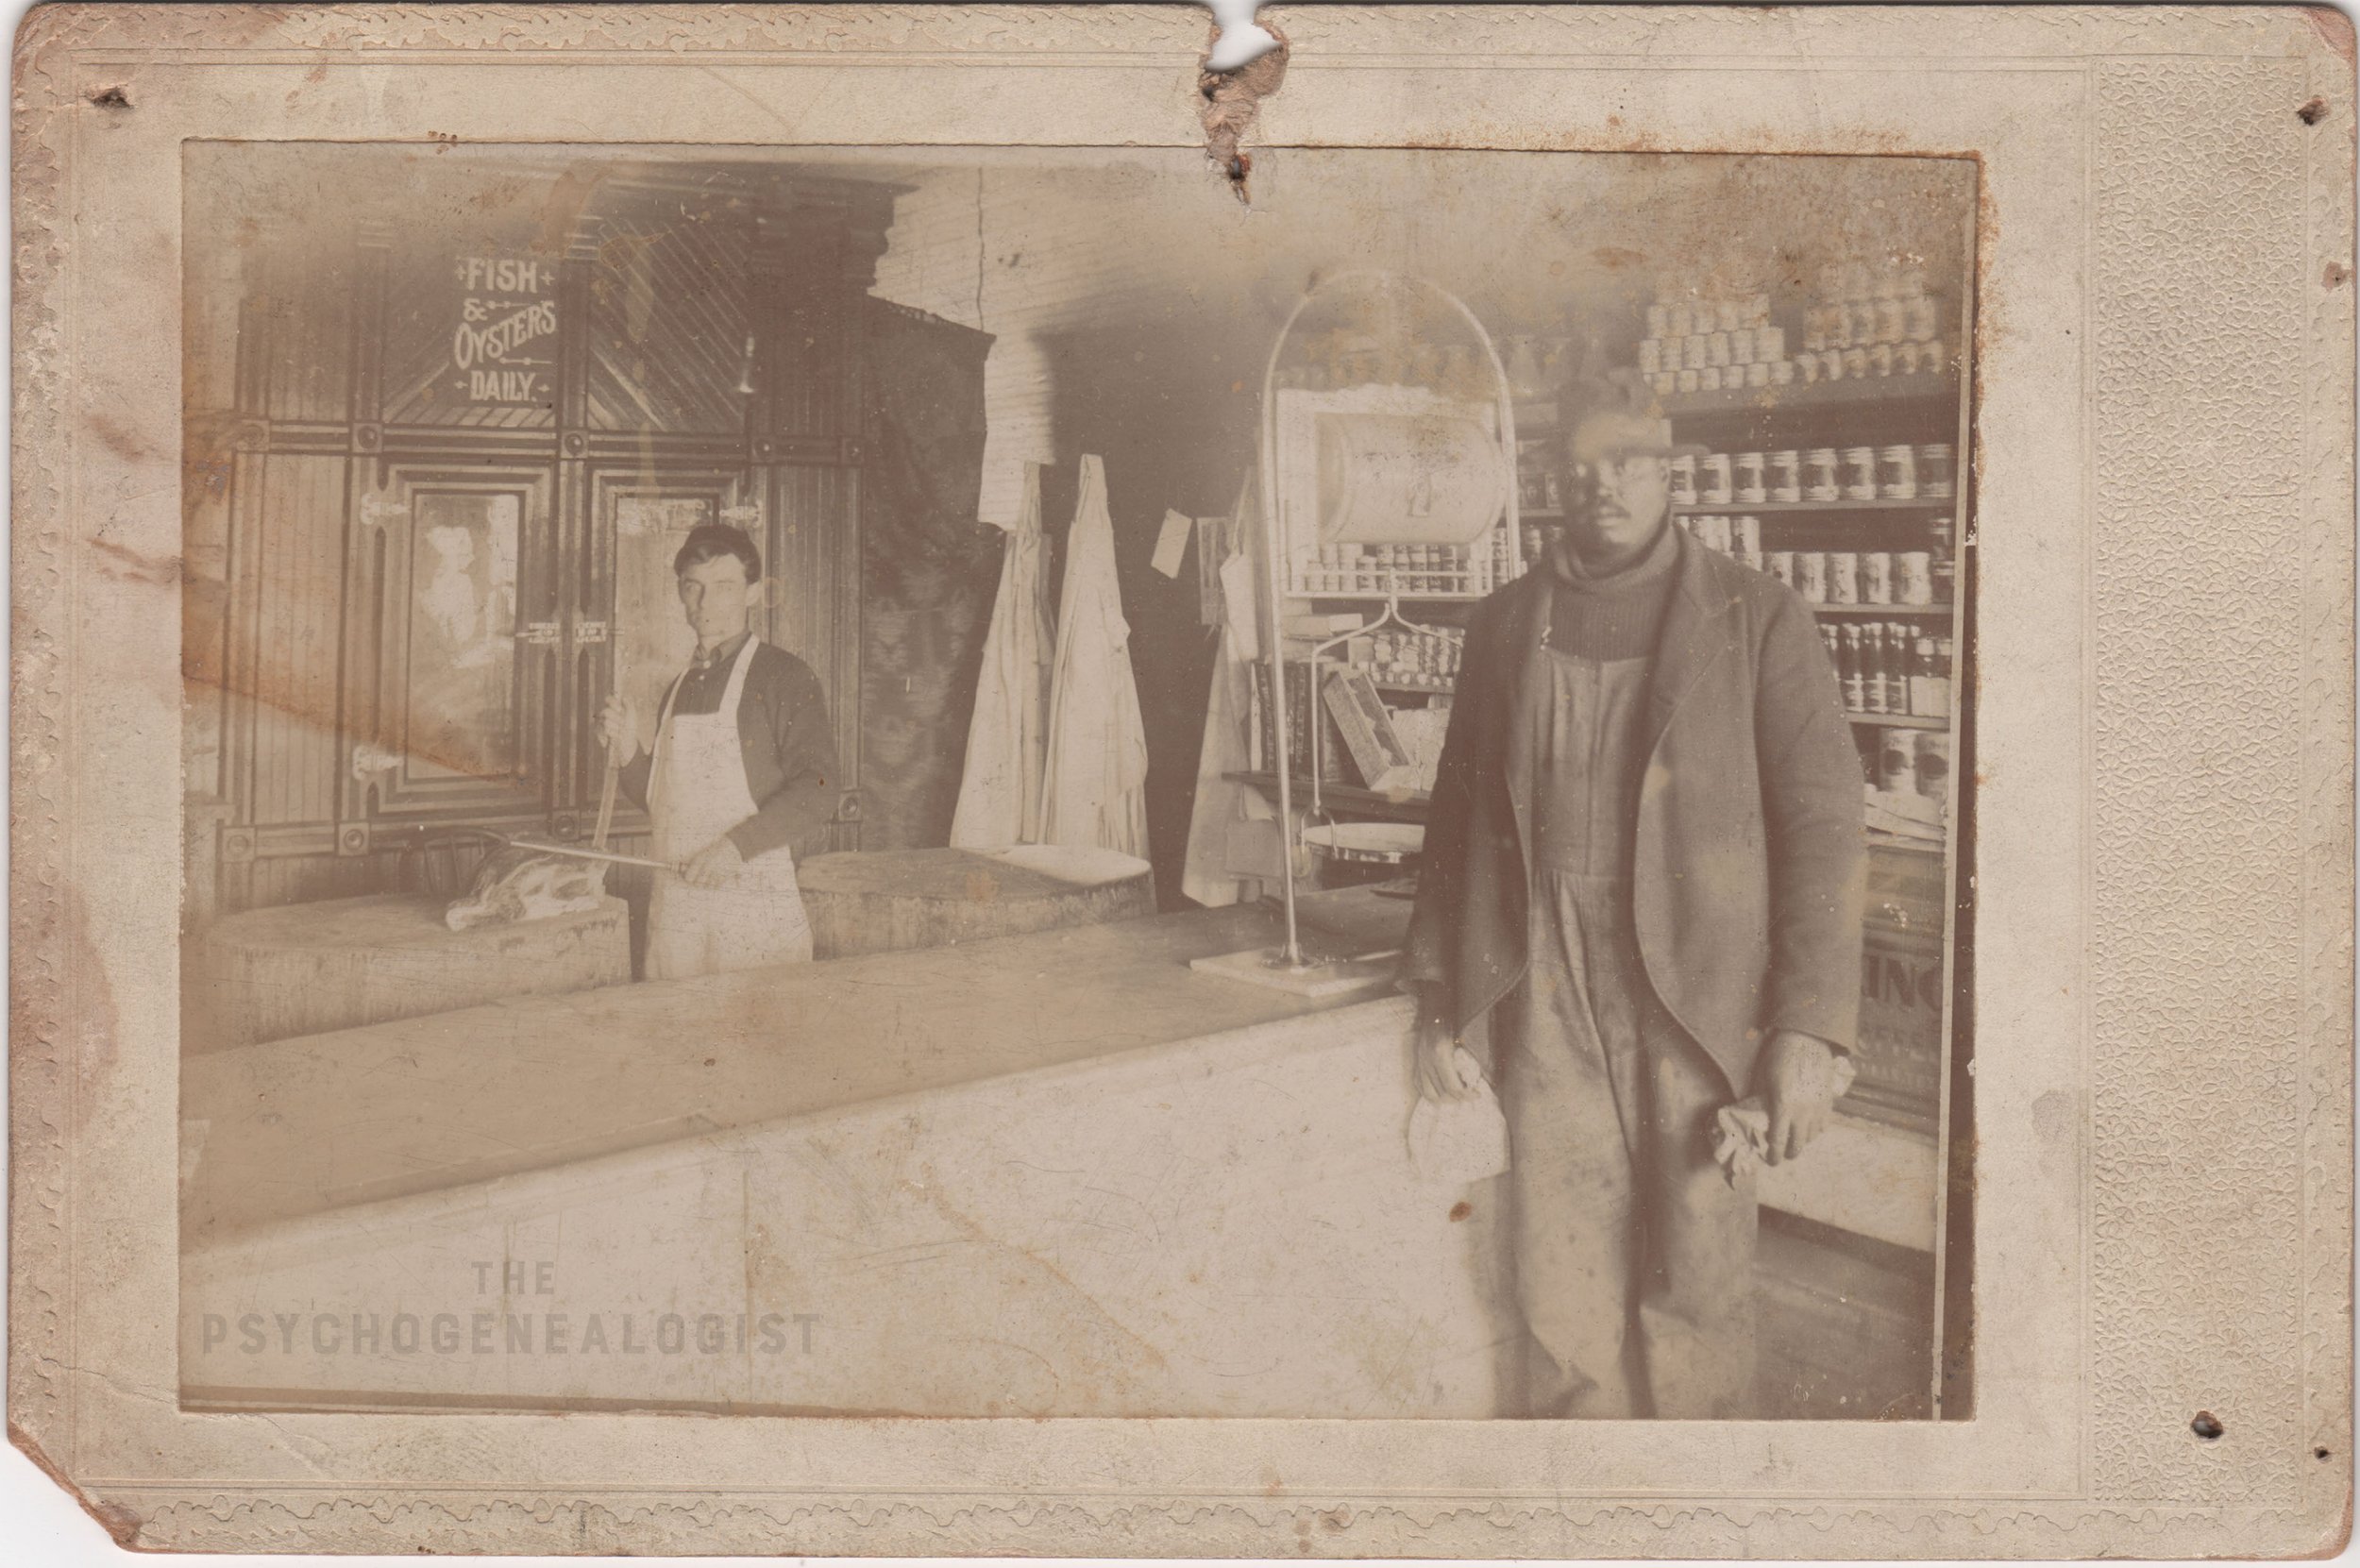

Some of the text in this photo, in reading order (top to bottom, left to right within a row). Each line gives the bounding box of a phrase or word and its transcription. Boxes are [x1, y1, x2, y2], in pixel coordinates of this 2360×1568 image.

[466, 258, 538, 294] FISH
[463, 297, 489, 322] &
[454, 300, 558, 370] OYSTERS
